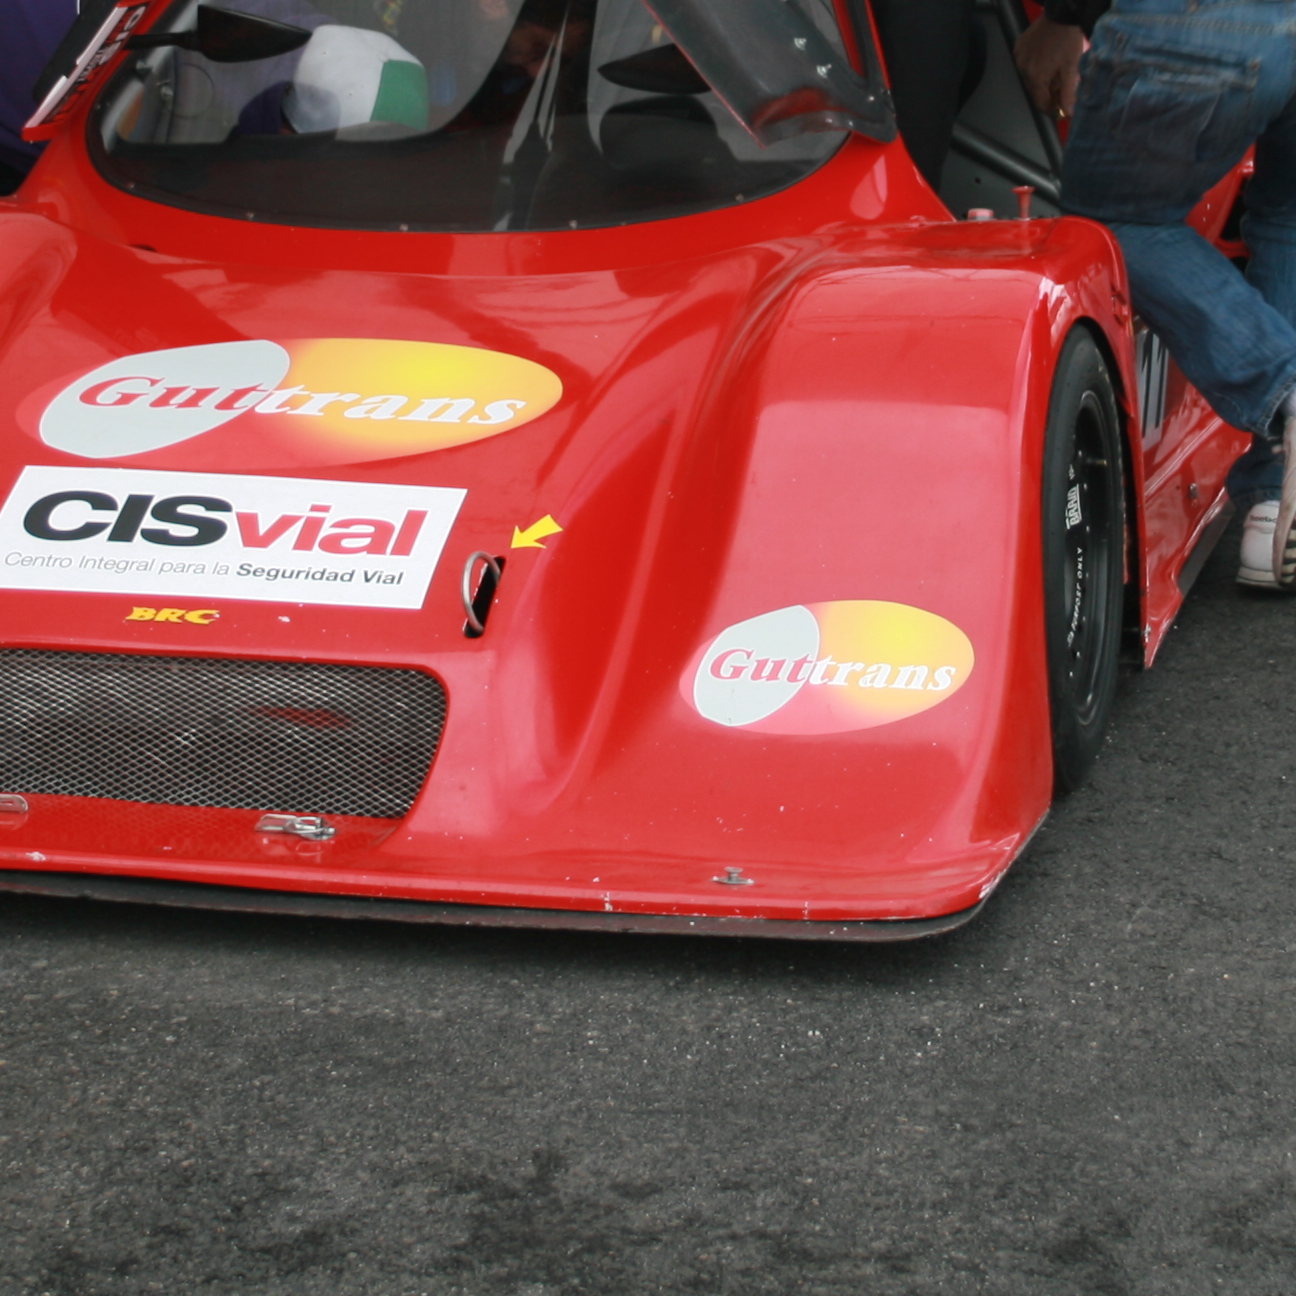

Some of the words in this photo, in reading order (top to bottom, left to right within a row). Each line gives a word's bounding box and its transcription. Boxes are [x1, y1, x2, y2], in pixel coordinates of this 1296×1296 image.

[78, 376, 526, 425] Guttrans
[5, 551, 73, 570] Centro
[78, 555, 156, 574] Integral
[158, 561, 206, 576] para
[212, 562, 230, 576] la
[236, 563, 356, 582] Seguridad
[363, 570, 404, 585] Vial
[125, 607, 220, 625] BRC
[710, 648, 957, 691] Guttrans
